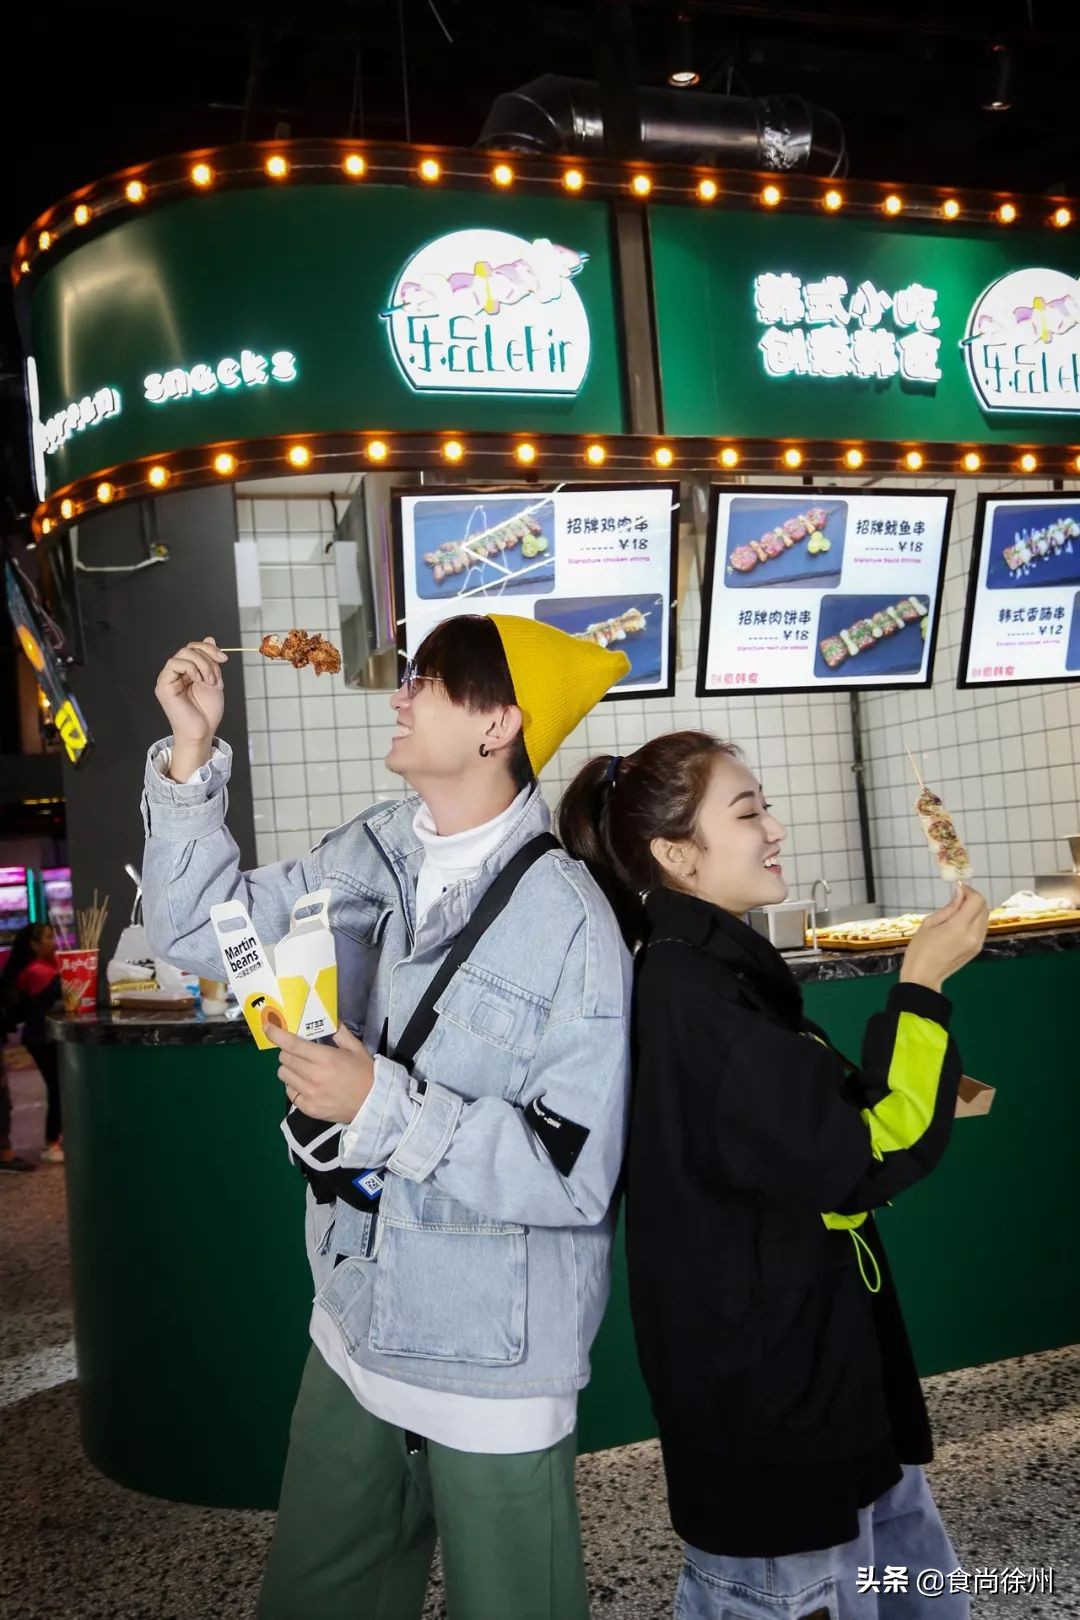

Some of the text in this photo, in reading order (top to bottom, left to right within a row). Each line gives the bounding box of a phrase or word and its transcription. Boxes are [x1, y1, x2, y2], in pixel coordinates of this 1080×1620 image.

[755, 272, 940, 332] 韩式小吃
[143, 350, 297, 403] snacks
[567, 515, 649, 535] 招牌鸡肉串
[856, 519, 926, 536] 招牌鱿鱼串
[738, 610, 812, 626] 招牌肉饼串
[998, 606, 1066, 623] 韩式香肠串
[224, 937, 257, 961] Martin
[229, 950, 259, 972] beans
